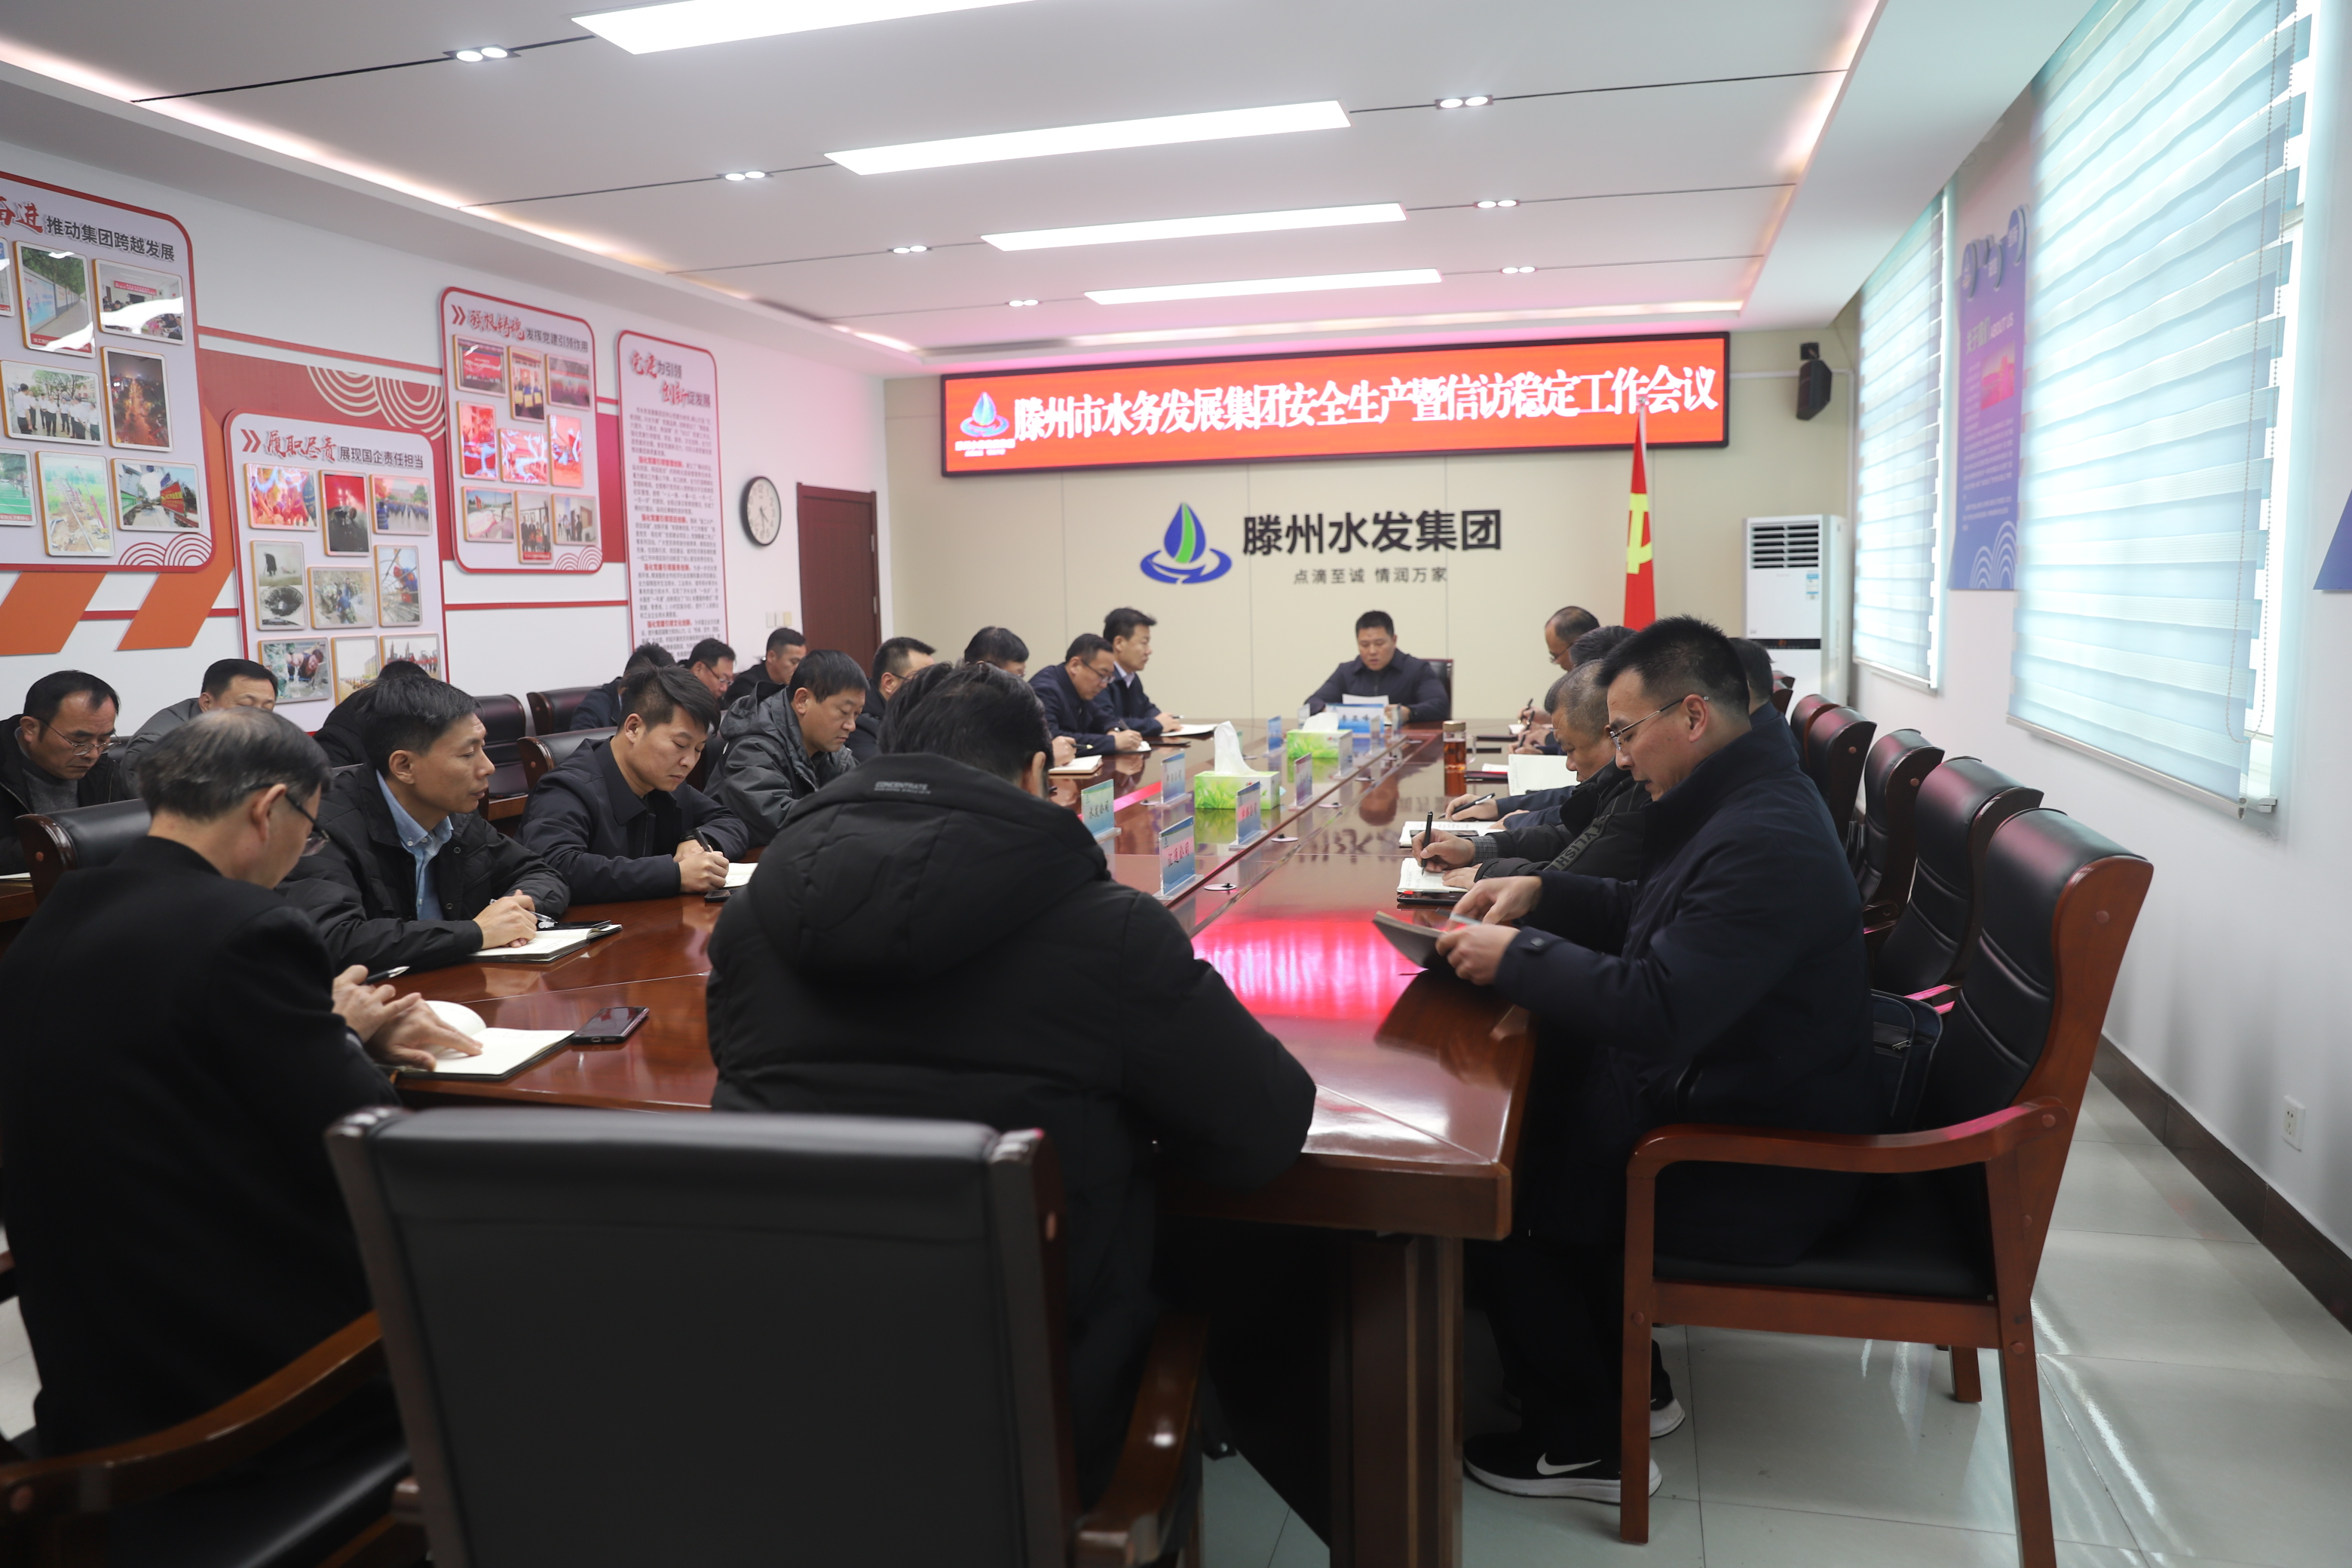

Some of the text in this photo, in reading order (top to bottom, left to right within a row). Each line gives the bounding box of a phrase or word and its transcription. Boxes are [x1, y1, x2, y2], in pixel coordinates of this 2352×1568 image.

[47, 216, 174, 262] 推动集团跨越发展
[527, 329, 588, 353] 发挥党建引领作用
[1015, 365, 1718, 442] 滕州市水务发展集团安全生产暨信访稳定工作会议
[266, 430, 423, 468] 履职尽责 展现国企责任担当
[1242, 510, 1502, 556] 滕州水发集团
[1294, 567, 1448, 585] 点滴至诚 情润万家
[875, 781, 928, 791] CONCENTRATE
